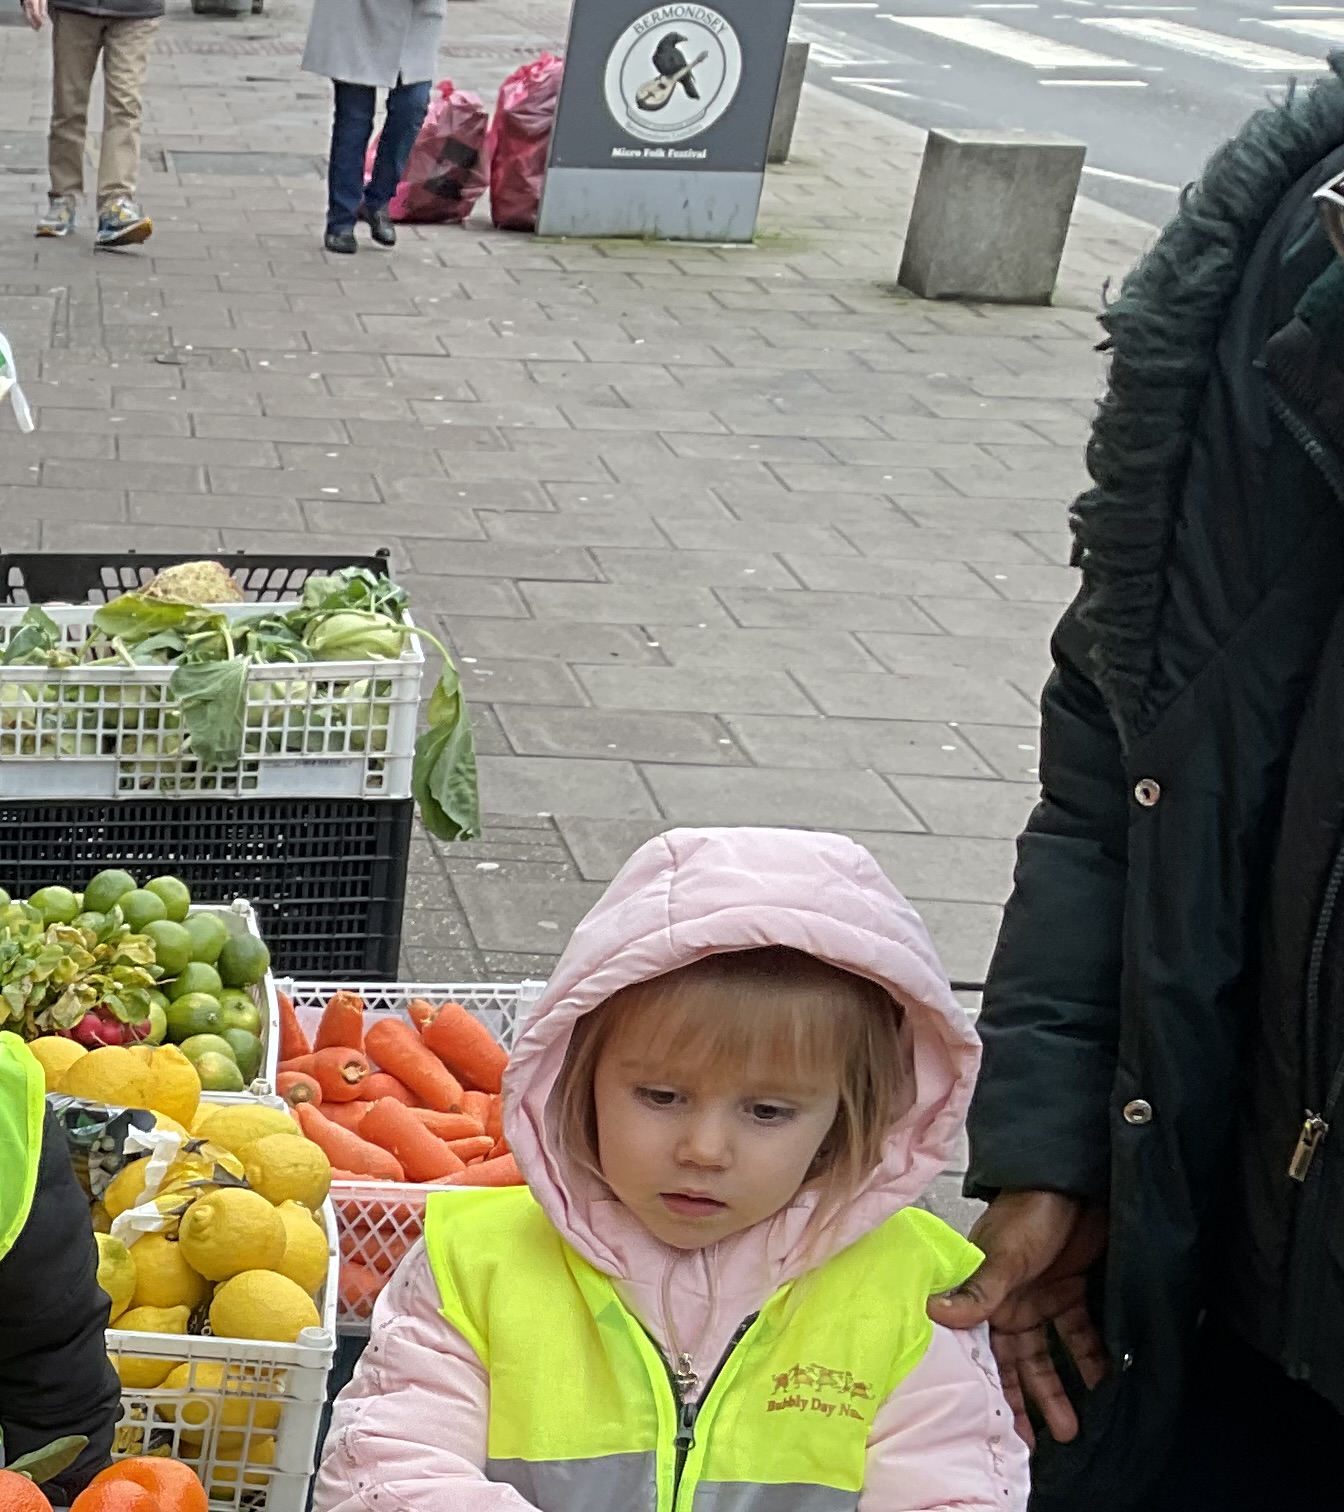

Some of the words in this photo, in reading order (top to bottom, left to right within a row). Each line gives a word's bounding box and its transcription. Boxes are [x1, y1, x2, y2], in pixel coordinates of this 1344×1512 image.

[633, 6, 729, 35] BERMONDSEY
[611, 147, 641, 157] Micro
[643, 147, 665, 157] Folk
[667, 148, 707, 159] Festival
[766, 1394, 809, 1412] Bubbly
[811, 1397, 837, 1418] Day
